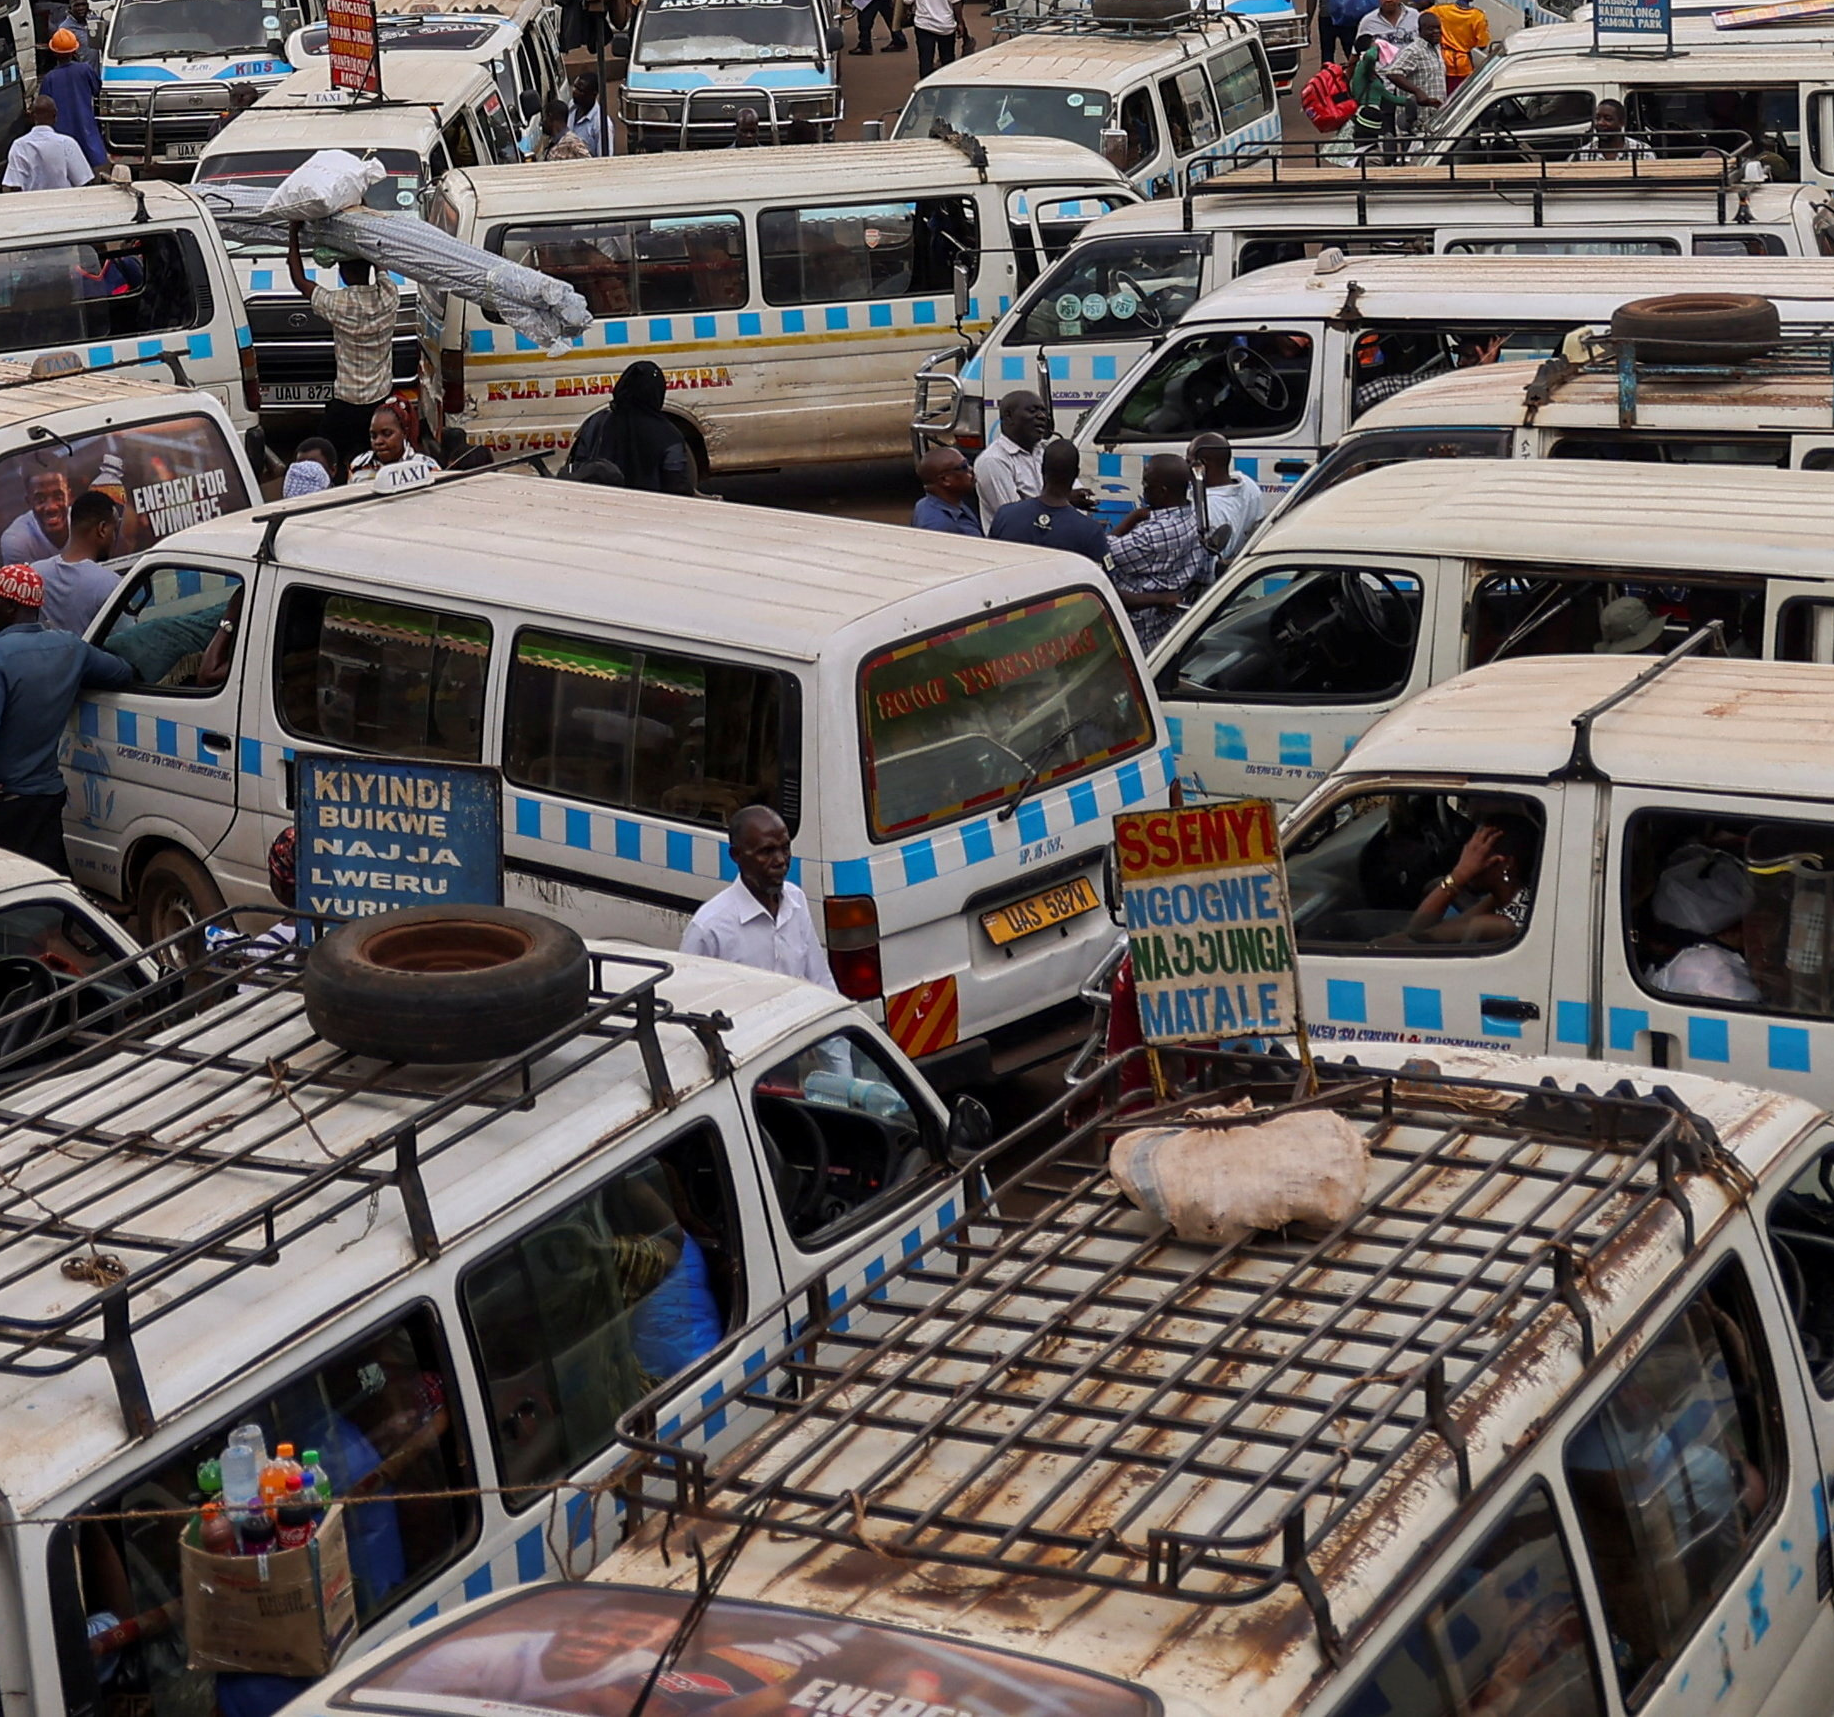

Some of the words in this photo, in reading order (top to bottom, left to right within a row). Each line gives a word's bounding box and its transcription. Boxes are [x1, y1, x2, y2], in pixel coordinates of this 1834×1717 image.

[1598, 6, 1661, 19] NALUKOLONGO
[1598, 17, 1635, 28] SAMONA
[1638, 18, 1663, 29] PARK
[235, 60, 272, 74] KIDS
[313, 92, 341, 103] TAXI
[132, 477, 191, 514] ENERGY
[196, 468, 229, 498] FOR
[388, 463, 427, 487] TAXI
[148, 496, 222, 539] WINNERS
[313, 769, 451, 812] KIYINDI
[318, 806, 448, 838] BUIKWE
[1115, 801, 1279, 873] SSENYI
[313, 838, 462, 867] NAJJA
[311, 868, 448, 895] LWERU
[1005, 901, 1040, 934] UAS
[1042, 882, 1089, 920] 587W
[1123, 876, 1279, 931] NGOGWE
[1140, 981, 1282, 1042] MATALE
